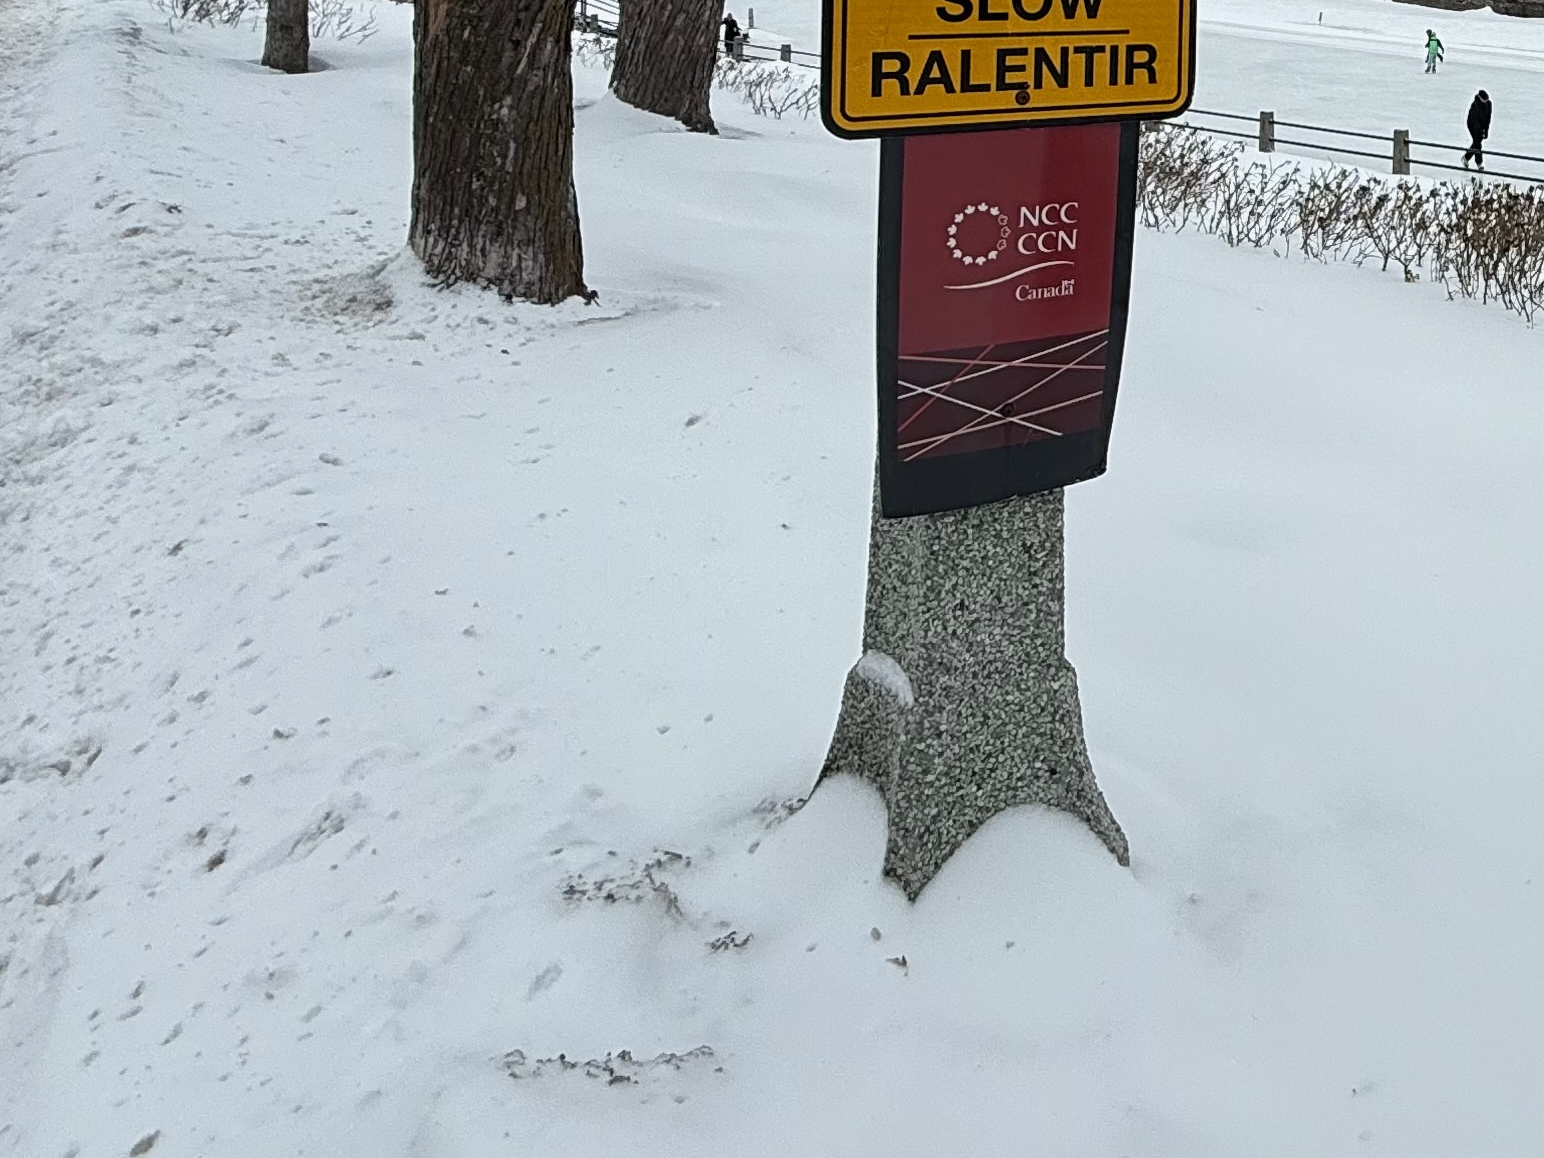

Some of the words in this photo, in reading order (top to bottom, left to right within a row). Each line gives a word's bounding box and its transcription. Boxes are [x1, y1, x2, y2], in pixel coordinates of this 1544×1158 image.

[871, 44, 1157, 97] RALENTIR
[1018, 202, 1079, 228] NCC
[1017, 229, 1078, 255] CCN
[1015, 279, 1075, 301] Canada
